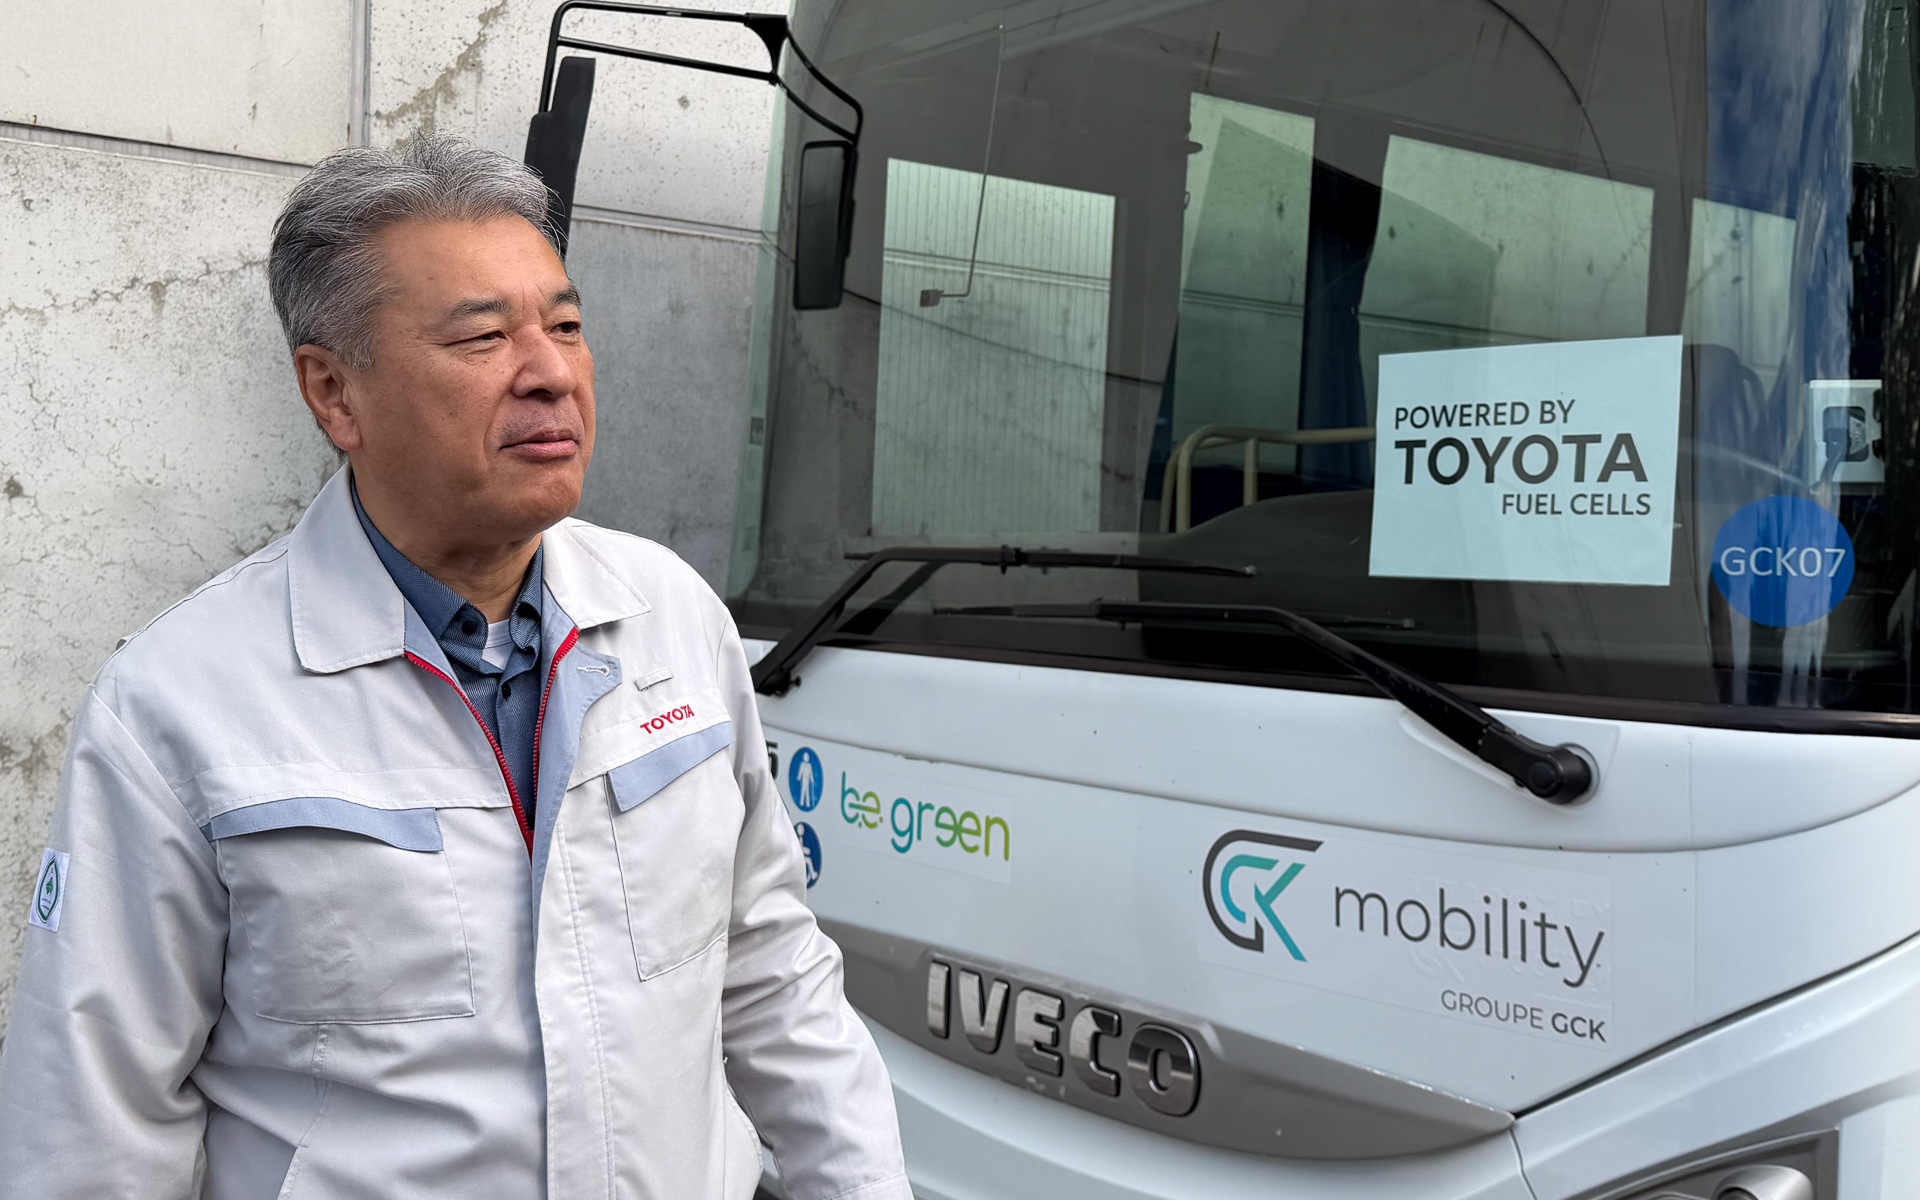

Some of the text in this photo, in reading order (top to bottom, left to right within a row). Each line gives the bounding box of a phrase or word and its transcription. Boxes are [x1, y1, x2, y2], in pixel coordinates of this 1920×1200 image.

[1394, 399, 1576, 430] POWERED BY
[1394, 433, 1649, 485] TOYOTA
[1502, 493, 1651, 516] FUEL CELLS
[1719, 547, 1846, 578] GCK07
[640, 704, 695, 735] TOYOTA
[891, 796, 1010, 861] green
[1334, 886, 1605, 988] mobility
[927, 960, 1202, 1118] IVECO
[1441, 989, 1607, 1042] GROUPE GCK
